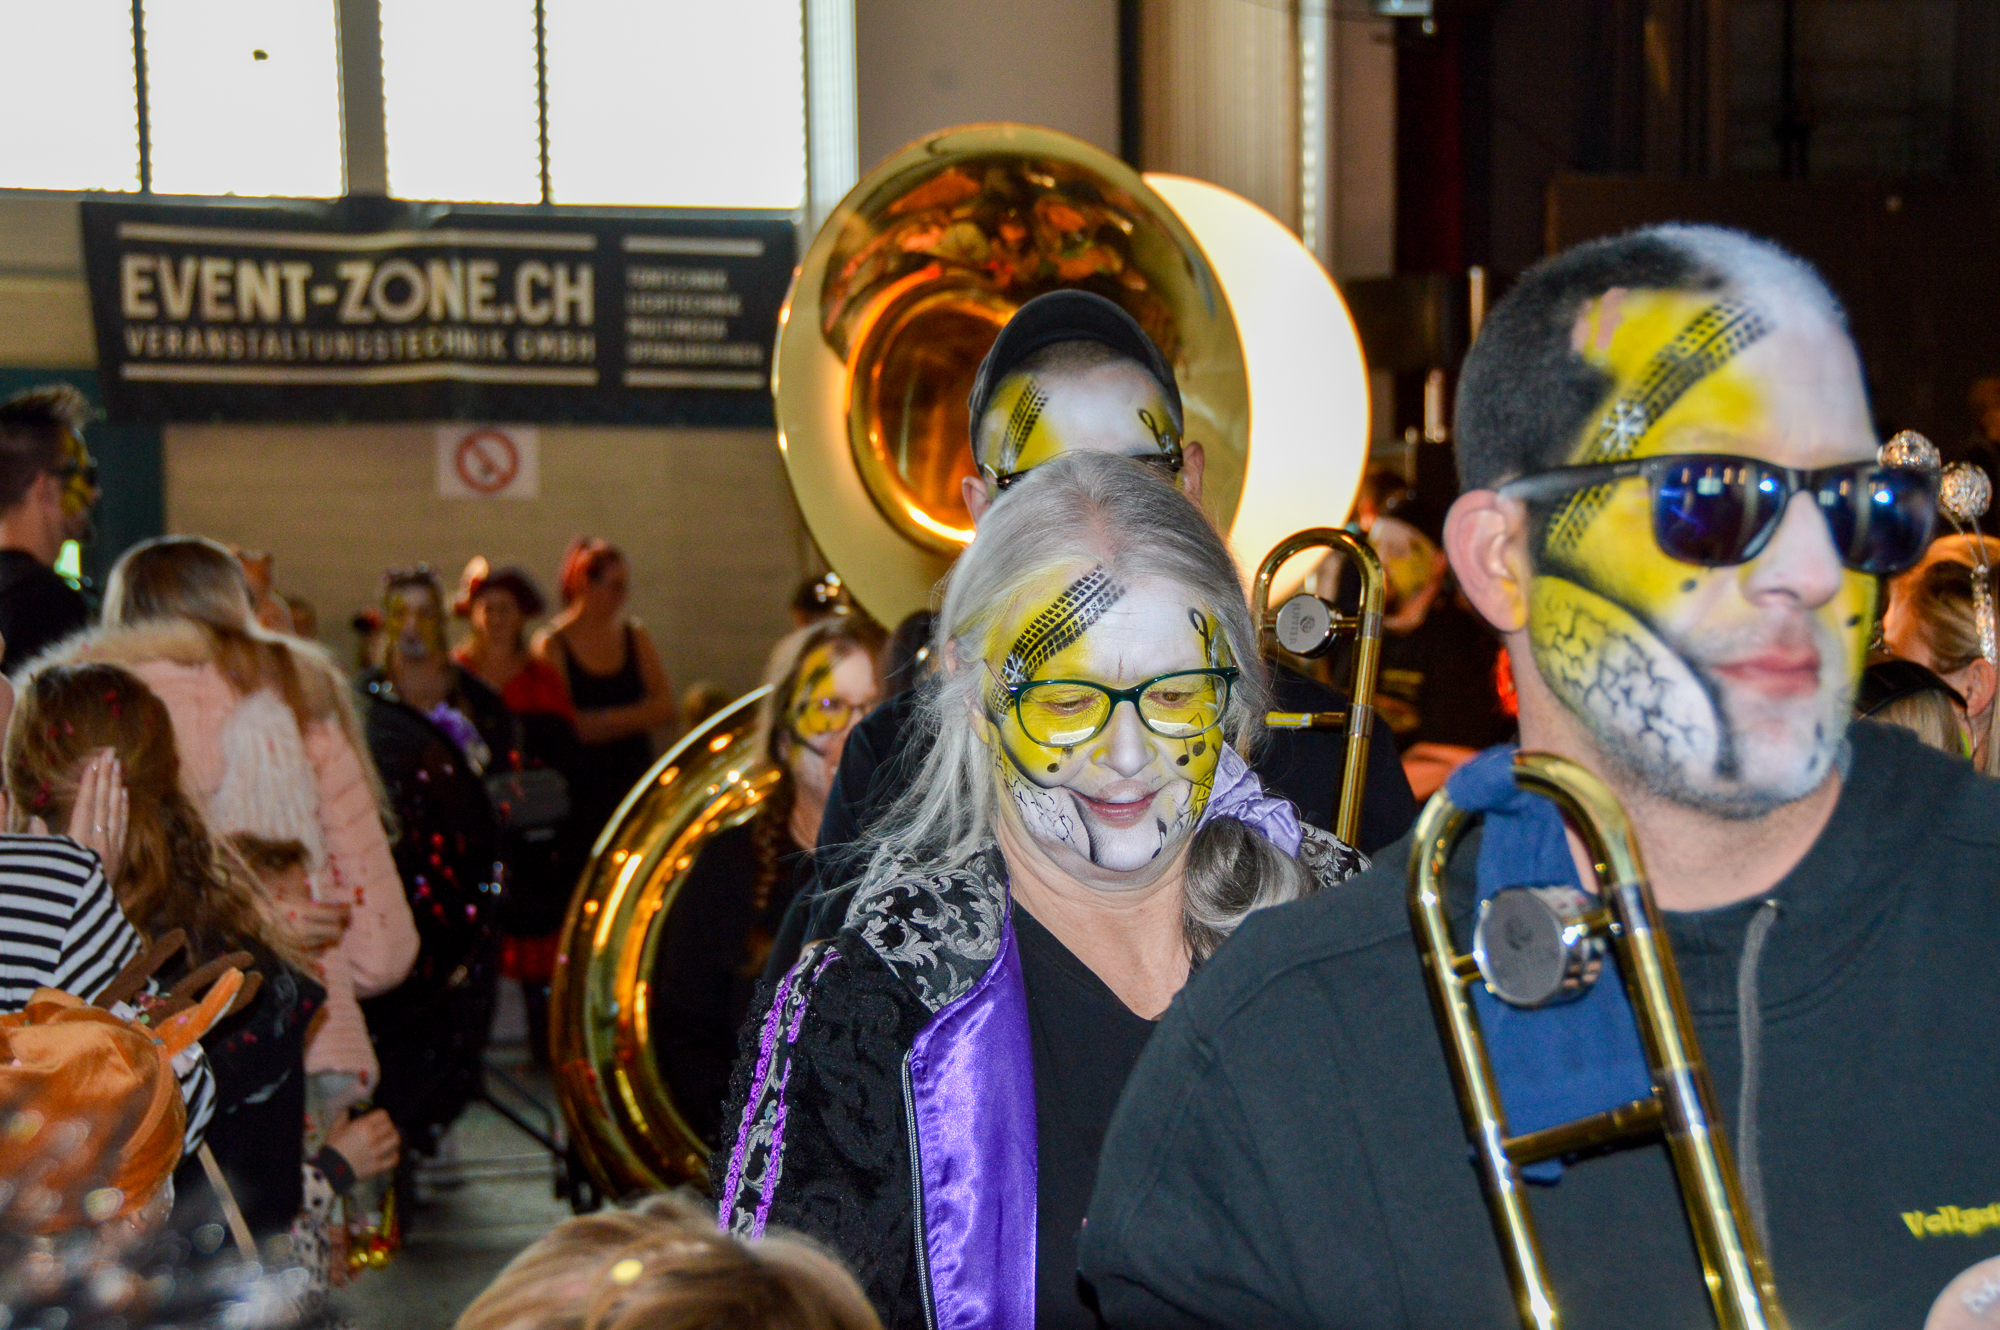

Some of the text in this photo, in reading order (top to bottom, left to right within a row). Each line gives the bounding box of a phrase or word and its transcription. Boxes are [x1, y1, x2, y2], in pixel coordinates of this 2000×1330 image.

[120, 253, 596, 327] EVENT-ZONE.CH
[124, 324, 507, 362] VERANSTALTUNGSTECHNIK
[514, 329, 597, 363] GMBH
